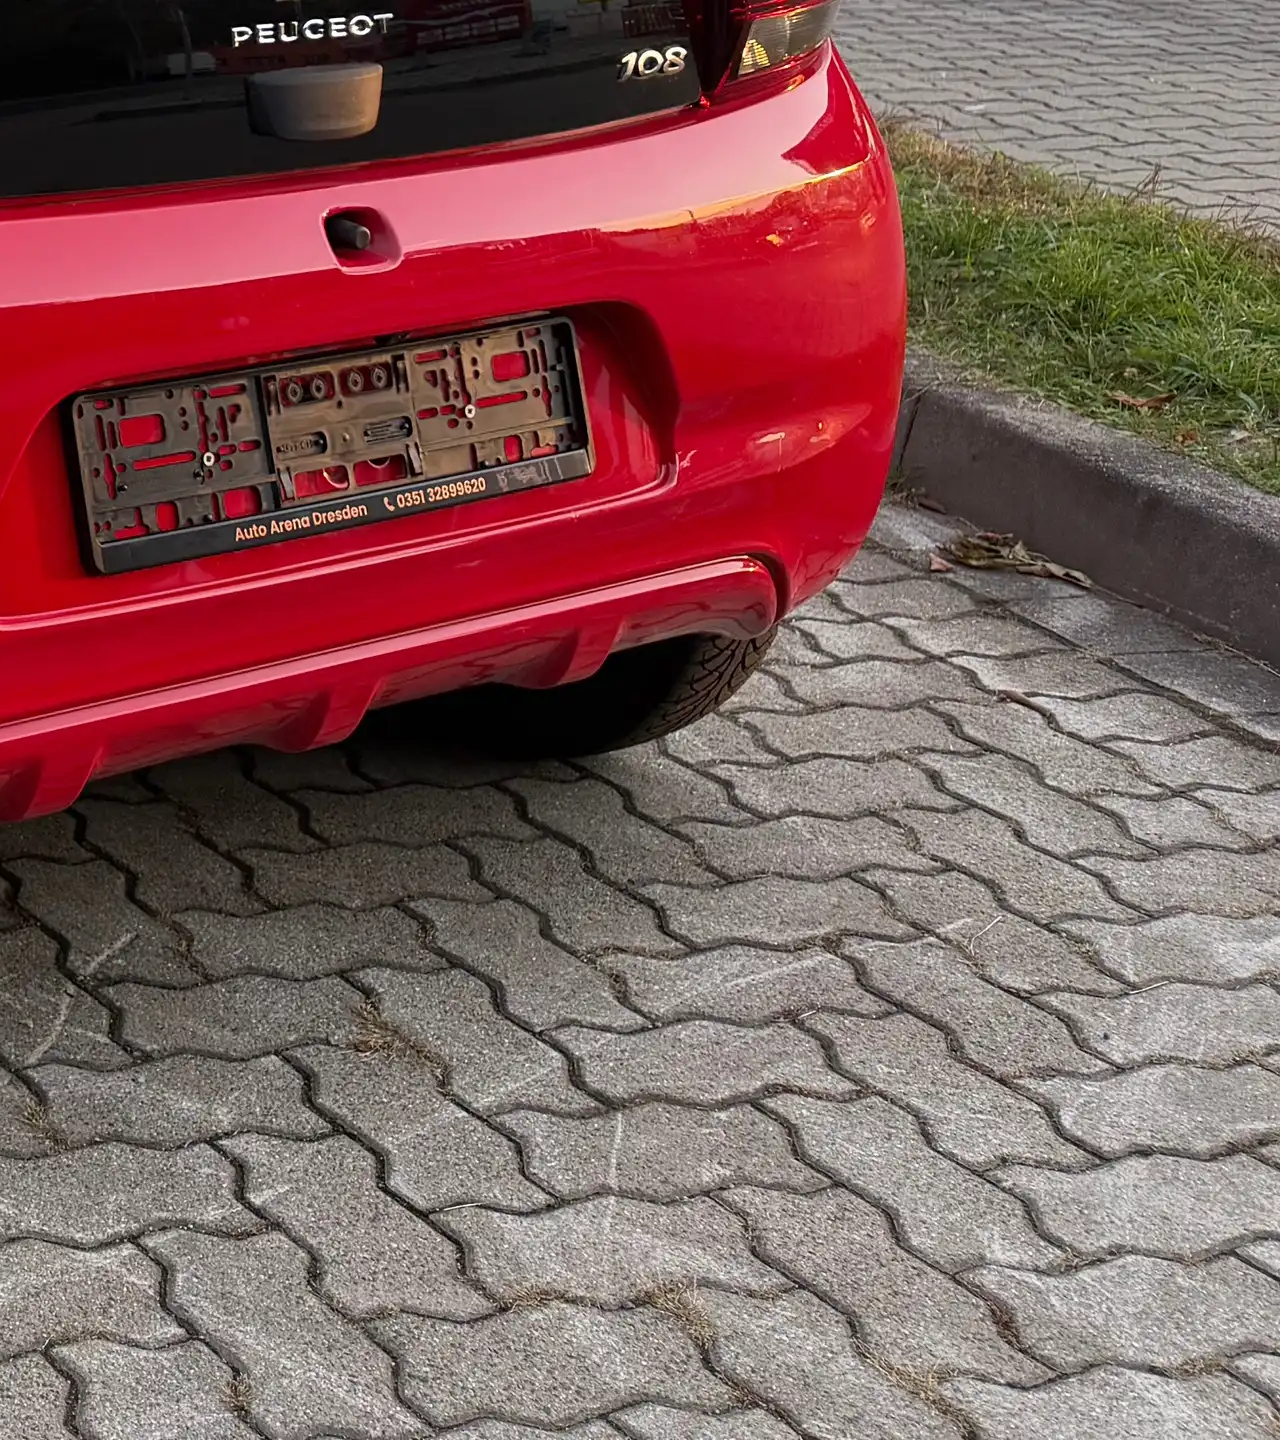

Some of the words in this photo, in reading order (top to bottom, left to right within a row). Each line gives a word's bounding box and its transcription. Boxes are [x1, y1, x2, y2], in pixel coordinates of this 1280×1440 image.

[230, 13, 395, 48] PEUGEOT
[615, 45, 689, 83] 108
[234, 523, 268, 543] Auto
[269, 516, 311, 536] Arena
[312, 502, 369, 528] Dresden
[396, 491, 426, 509] 0351
[427, 477, 487, 503] 32899620
